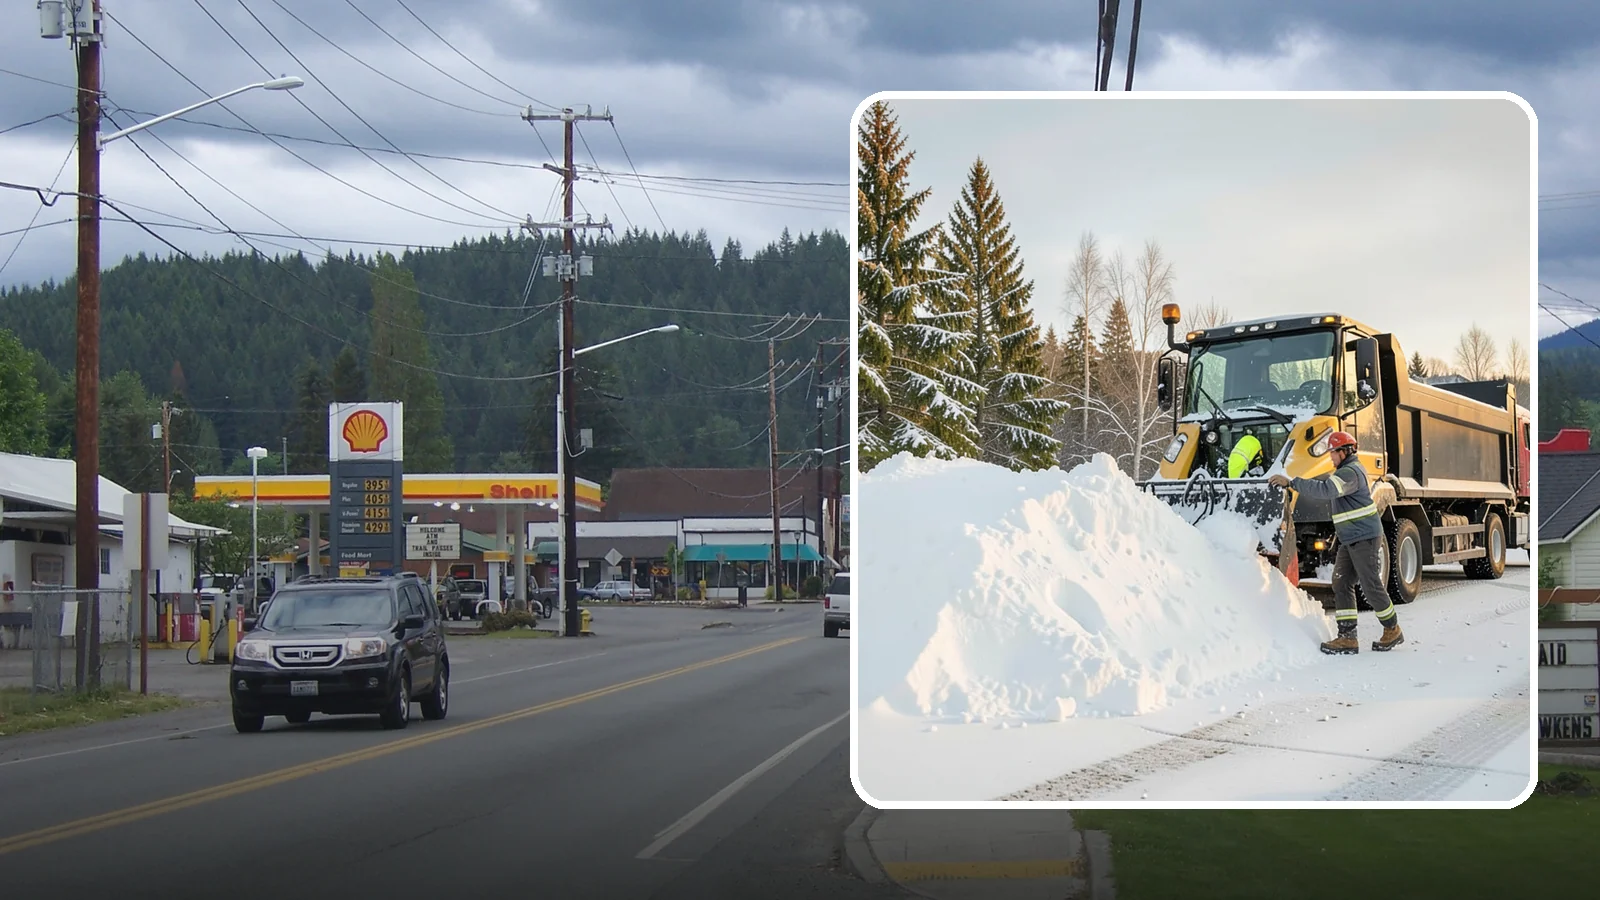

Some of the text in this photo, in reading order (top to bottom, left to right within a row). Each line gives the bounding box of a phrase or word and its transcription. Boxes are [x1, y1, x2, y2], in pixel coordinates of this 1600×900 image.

[365, 479, 383, 490] 395
[490, 484, 547, 499] Shell
[365, 494, 383, 504] 405
[365, 508, 383, 518] 415
[365, 522, 383, 532] 429
[1538, 643, 1566, 665] AID
